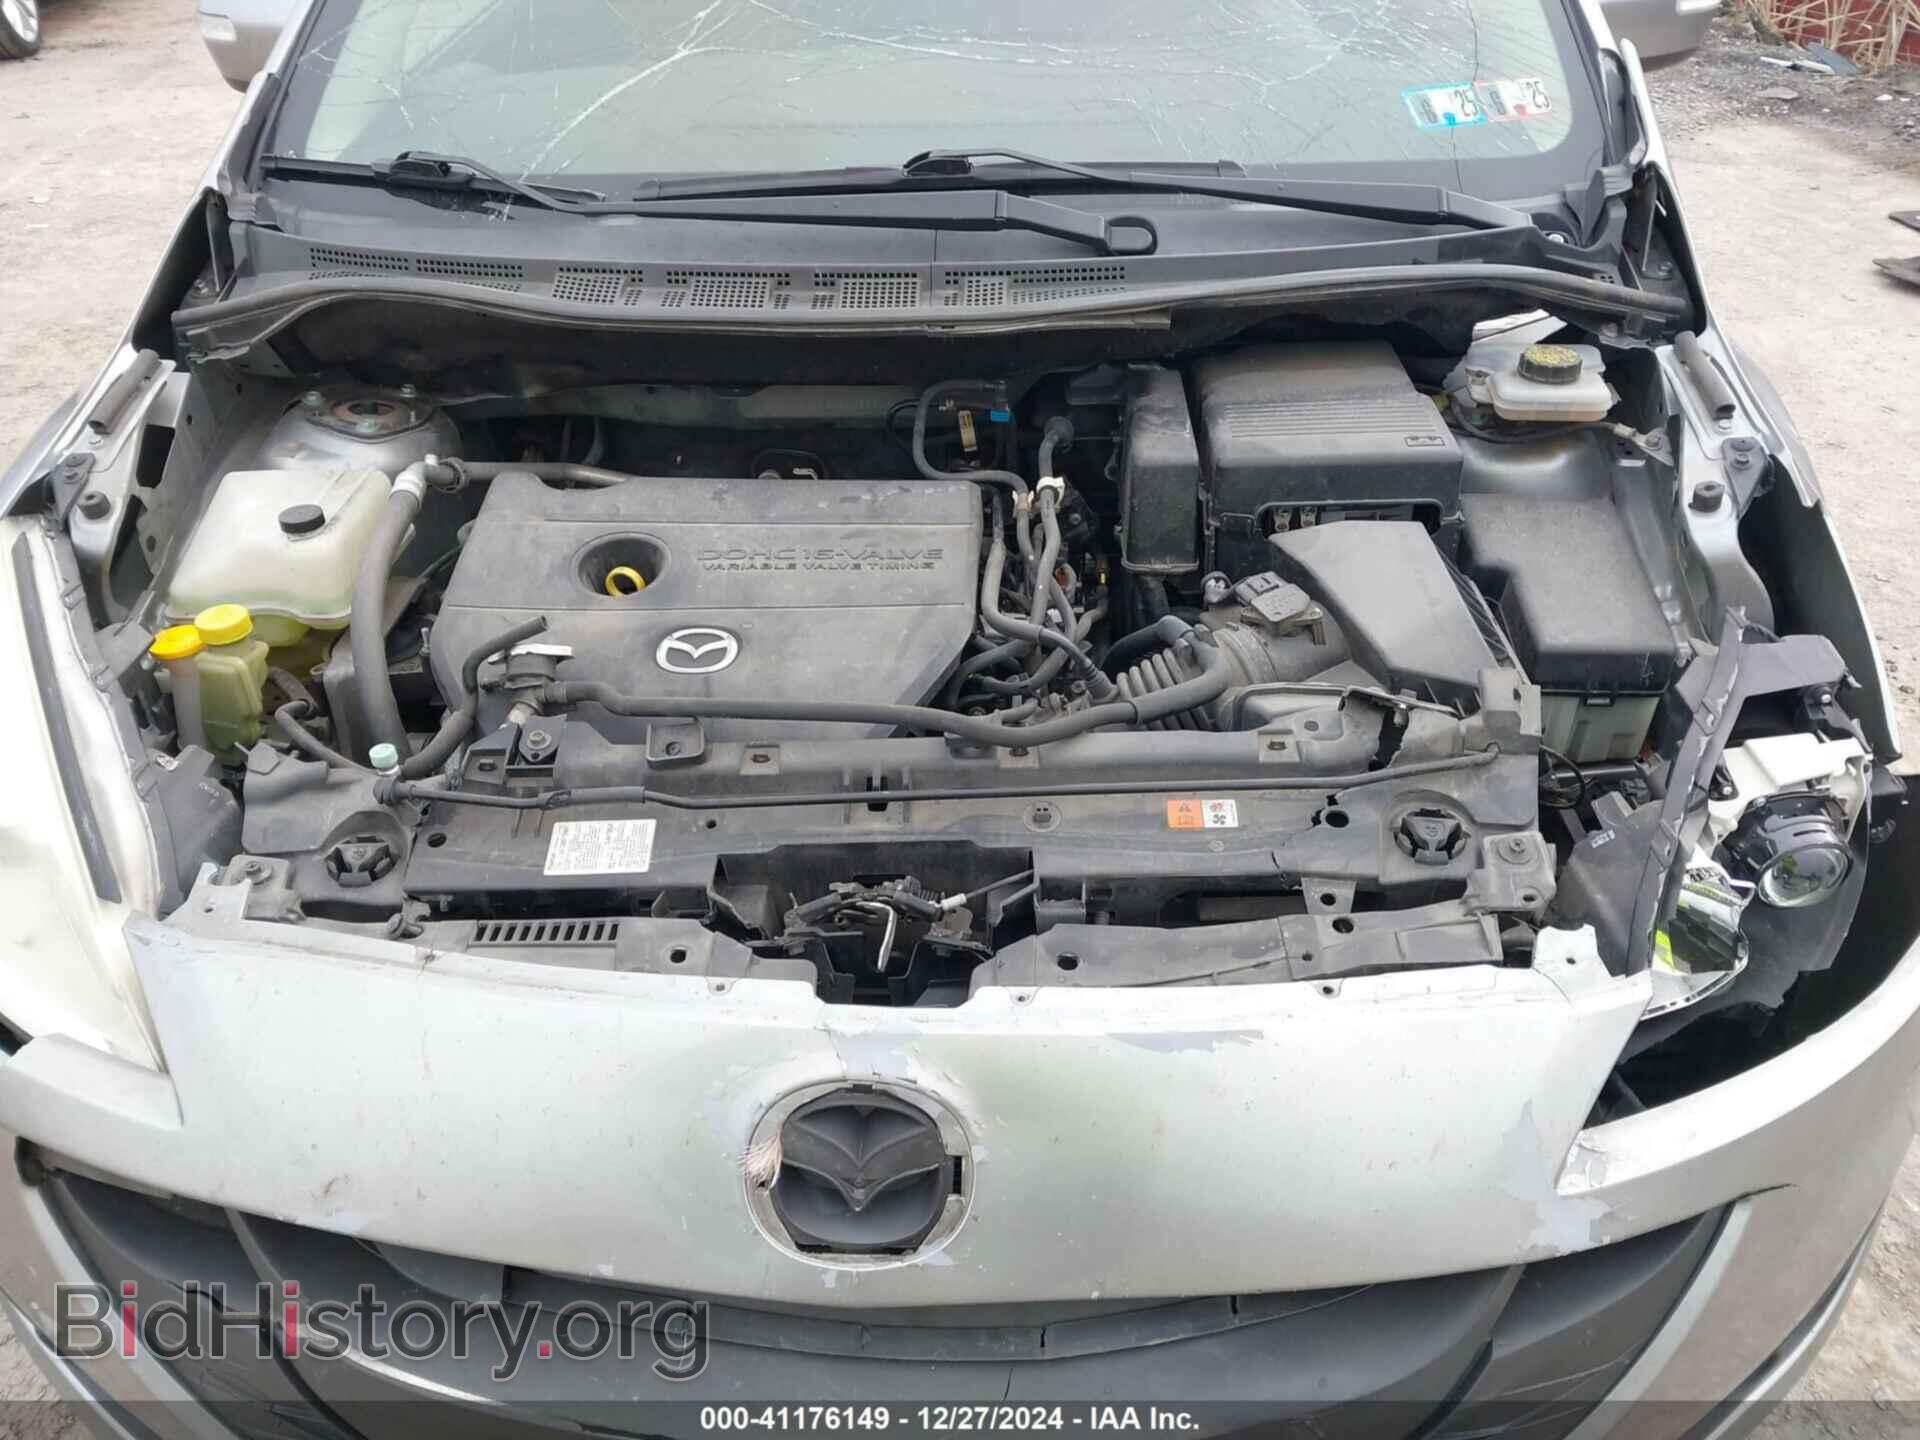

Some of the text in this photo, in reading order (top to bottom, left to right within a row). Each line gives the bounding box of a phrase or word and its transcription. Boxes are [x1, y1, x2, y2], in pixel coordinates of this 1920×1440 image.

[1454, 89, 1478, 117] 25
[1525, 80, 1551, 109] 25
[697, 548, 797, 561] DOHC
[702, 561, 936, 572] VARIABLE VALVE TIMING
